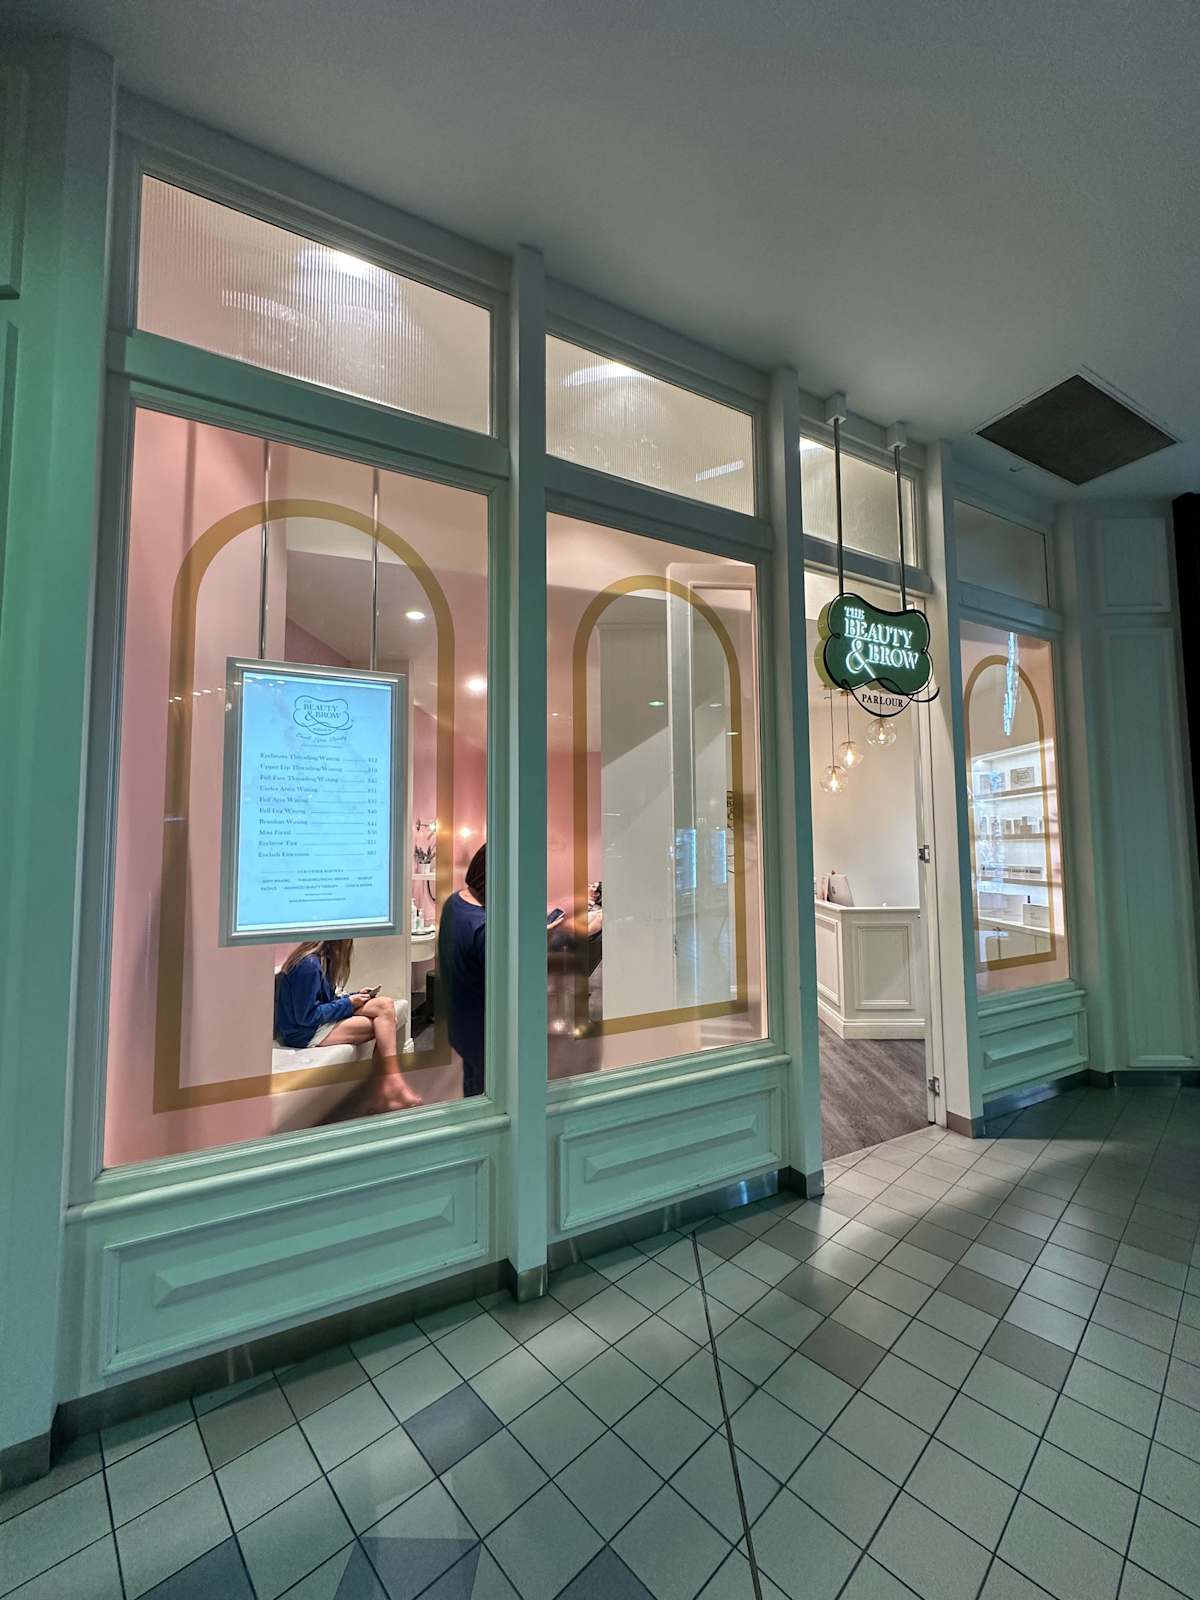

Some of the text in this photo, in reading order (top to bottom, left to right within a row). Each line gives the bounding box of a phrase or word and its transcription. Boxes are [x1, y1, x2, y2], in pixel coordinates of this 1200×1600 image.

[843, 606, 865, 620] THE
[844, 617, 913, 648] BEAUTY
[845, 638, 919, 678] & BROW
[862, 694, 903, 707] PARLOUR
[303, 703, 339, 713] BEAUTY
[315, 711, 342, 720] BROW
